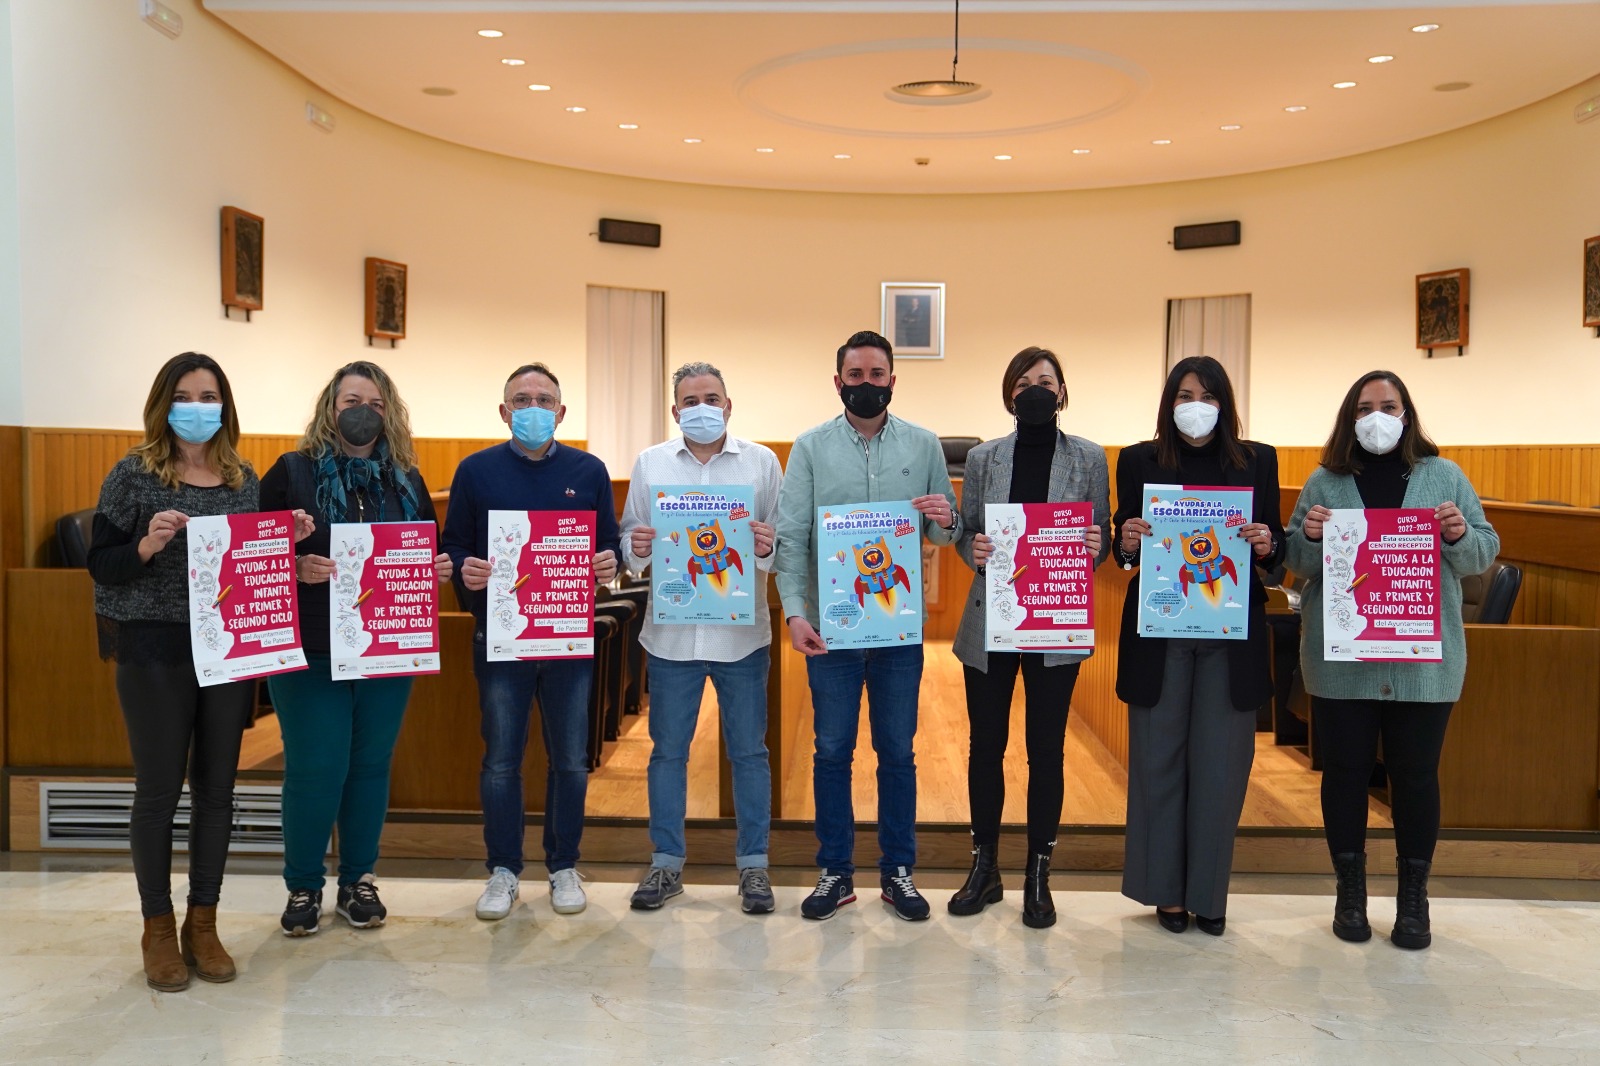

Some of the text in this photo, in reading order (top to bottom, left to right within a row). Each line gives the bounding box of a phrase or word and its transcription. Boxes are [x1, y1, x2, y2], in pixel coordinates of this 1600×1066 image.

[660, 499, 744, 510] ESCOLARIZACIÓN
[1054, 510, 1072, 518] CURSO
[1153, 506, 1242, 517] ESCOLARIZACIÓN
[258, 519, 275, 529] CURSO
[558, 518, 576, 526] CURSO
[826, 515, 910, 530] ESCOLARIZACIÓN
[1054, 516, 1084, 526] 2022-2023
[1397, 516, 1417, 524] CURSO
[259, 526, 287, 537] 2022-2023
[559, 526, 588, 534] 2022-2023
[1398, 523, 1431, 532] 2022-2023
[402, 537, 429, 547] 2022-2023
[233, 547, 288, 557] CENTRO RECEPTOR
[1031, 546, 1086, 556] AYUDAS A LA
[534, 555, 589, 565] AYUDAS A LA
[1372, 554, 1433, 564] AYUDAS A LA
[235, 558, 290, 574] AYUDAS A LA
[377, 568, 432, 579] AYUDAS A LA
[1048, 571, 1087, 580] INFANTIL
[551, 580, 588, 589] INFANTIL
[1029, 583, 1087, 592] DE PRIMER Y
[1392, 580, 1433, 589] INFANTIL
[254, 586, 291, 599] INFANTIL
[531, 592, 589, 602] DE PRIMER Y
[1370, 592, 1433, 602] DE PRIMER Y
[395, 593, 432, 603] INFANTIL
[1023, 595, 1087, 604] SEGUNDO CICLO
[234, 598, 292, 615] DE PRIMER Y
[374, 605, 432, 617] DE PRIMER Y
[524, 604, 588, 614] SEGUNDO CICLO
[1363, 605, 1433, 614] SEGUNDO CICLO
[229, 611, 292, 629] SEGUNDO CICLO
[368, 617, 432, 629] SEGUNDO CICLO
[253, 629, 292, 639] Ayuntamiento
[273, 636, 293, 644] Paterna
